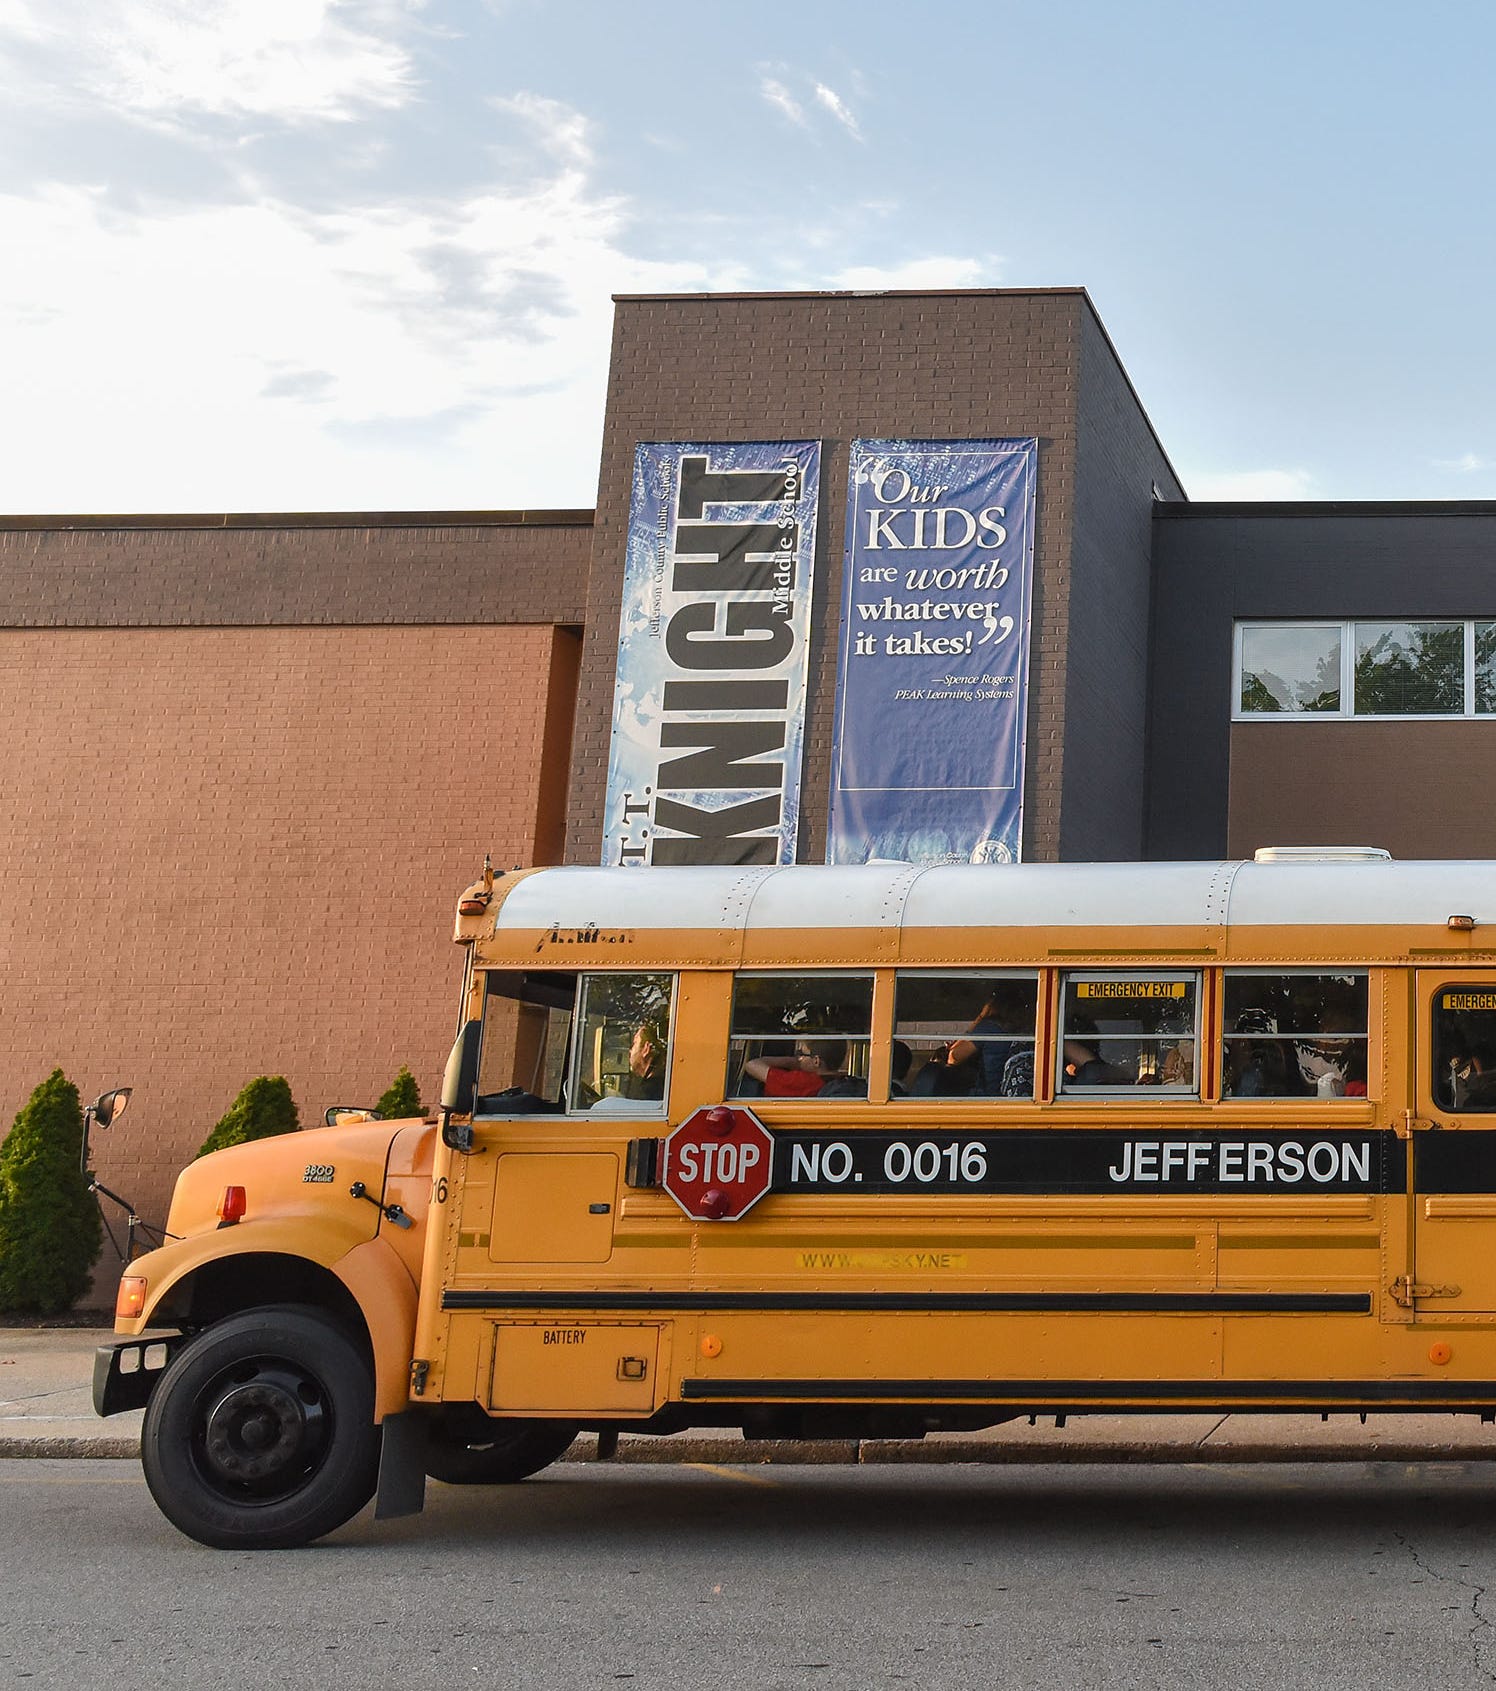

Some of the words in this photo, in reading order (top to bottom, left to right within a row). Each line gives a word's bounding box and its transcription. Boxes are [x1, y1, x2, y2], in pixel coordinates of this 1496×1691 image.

[777, 456, 799, 530] School
[656, 504, 670, 539] Public
[863, 506, 1008, 550] KIDS
[654, 544, 668, 584] County
[771, 535, 794, 615] Middle
[860, 567, 898, 583] are
[905, 558, 1009, 590] worth
[856, 596, 1000, 620] whatever
[854, 631, 878, 655] it
[651, 456, 802, 866] KNIGHT
[894, 689, 926, 700] PEAK
[926, 689, 973, 701] Learning
[974, 689, 1014, 701] Systems
[981, 674, 1015, 686] Rogers
[1088, 983, 1150, 997] EMERGENCY
[1152, 982, 1175, 996] EXIT
[304, 1164, 335, 1177] 3800
[678, 1142, 760, 1184] STOP
[790, 1142, 864, 1183] NO.
[883, 1141, 988, 1183] 0016
[1109, 1141, 1371, 1183] JEFFERSON
[543, 1329, 587, 1345] BATTERY
